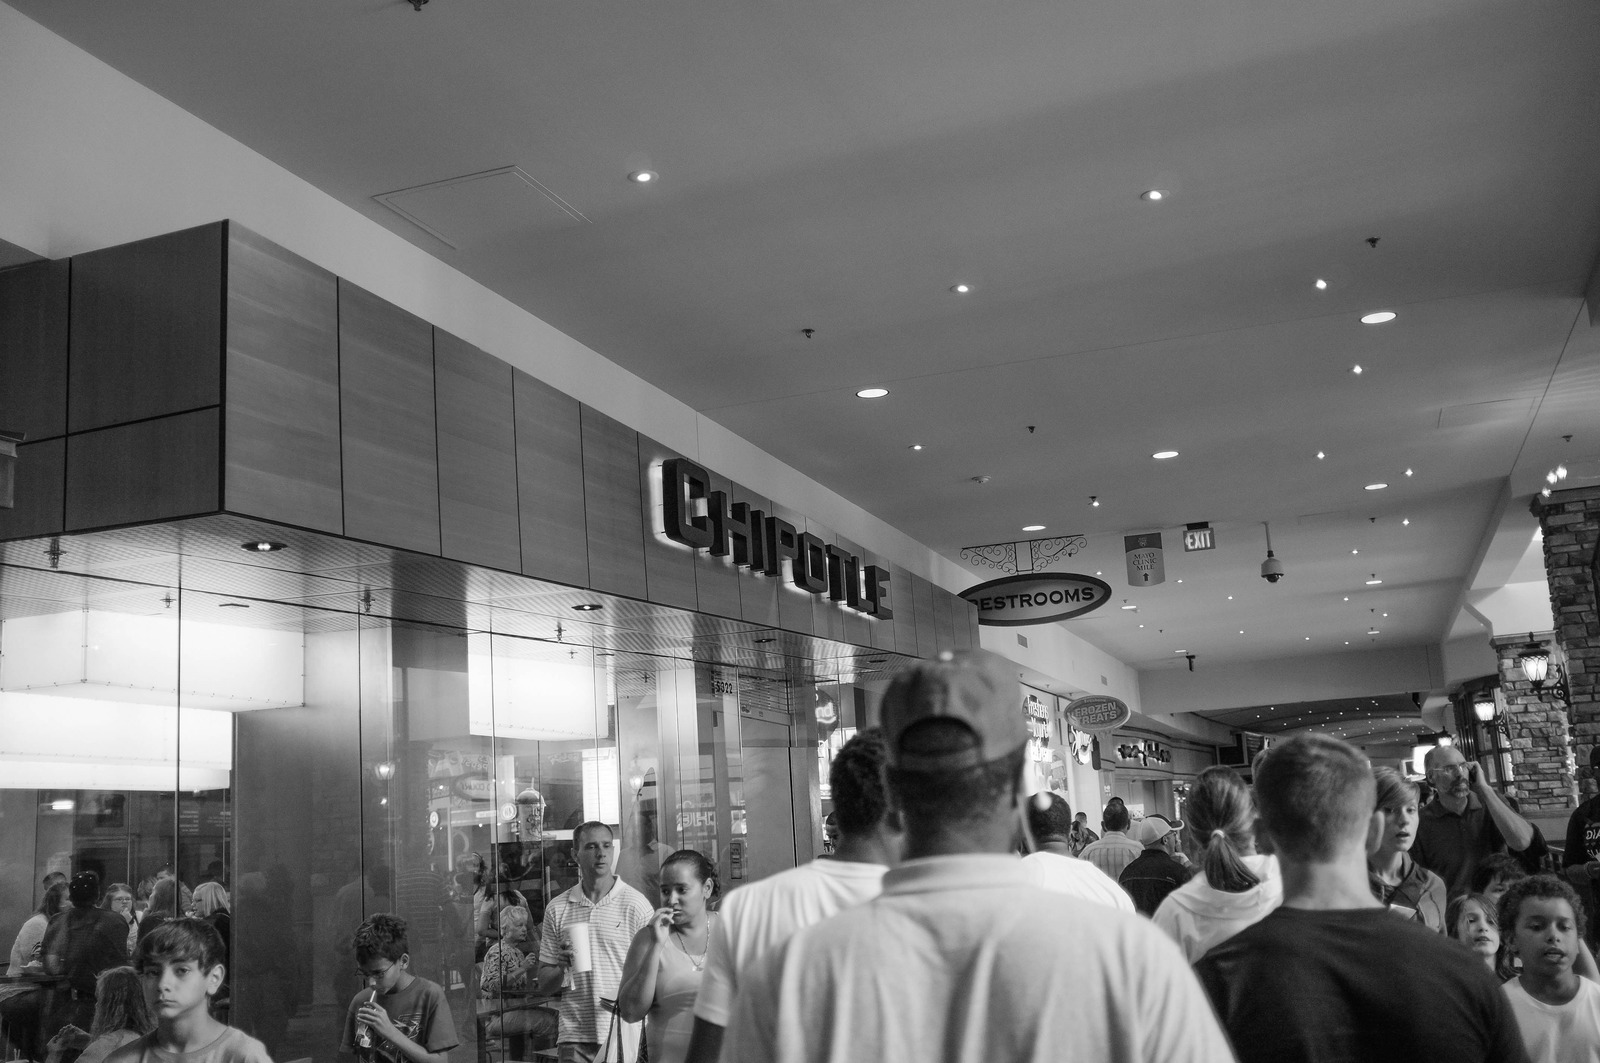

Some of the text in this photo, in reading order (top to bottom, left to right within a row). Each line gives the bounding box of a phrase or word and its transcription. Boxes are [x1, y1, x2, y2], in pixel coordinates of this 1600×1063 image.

[661, 457, 893, 620] CHIPOTLE
[1187, 530, 1211, 549] EXIT
[1132, 557, 1157, 566] CLINIC
[1134, 552, 1155, 560] MAYO
[1074, 701, 1117, 717] FROZEN
[1077, 710, 1117, 724] TREATS
